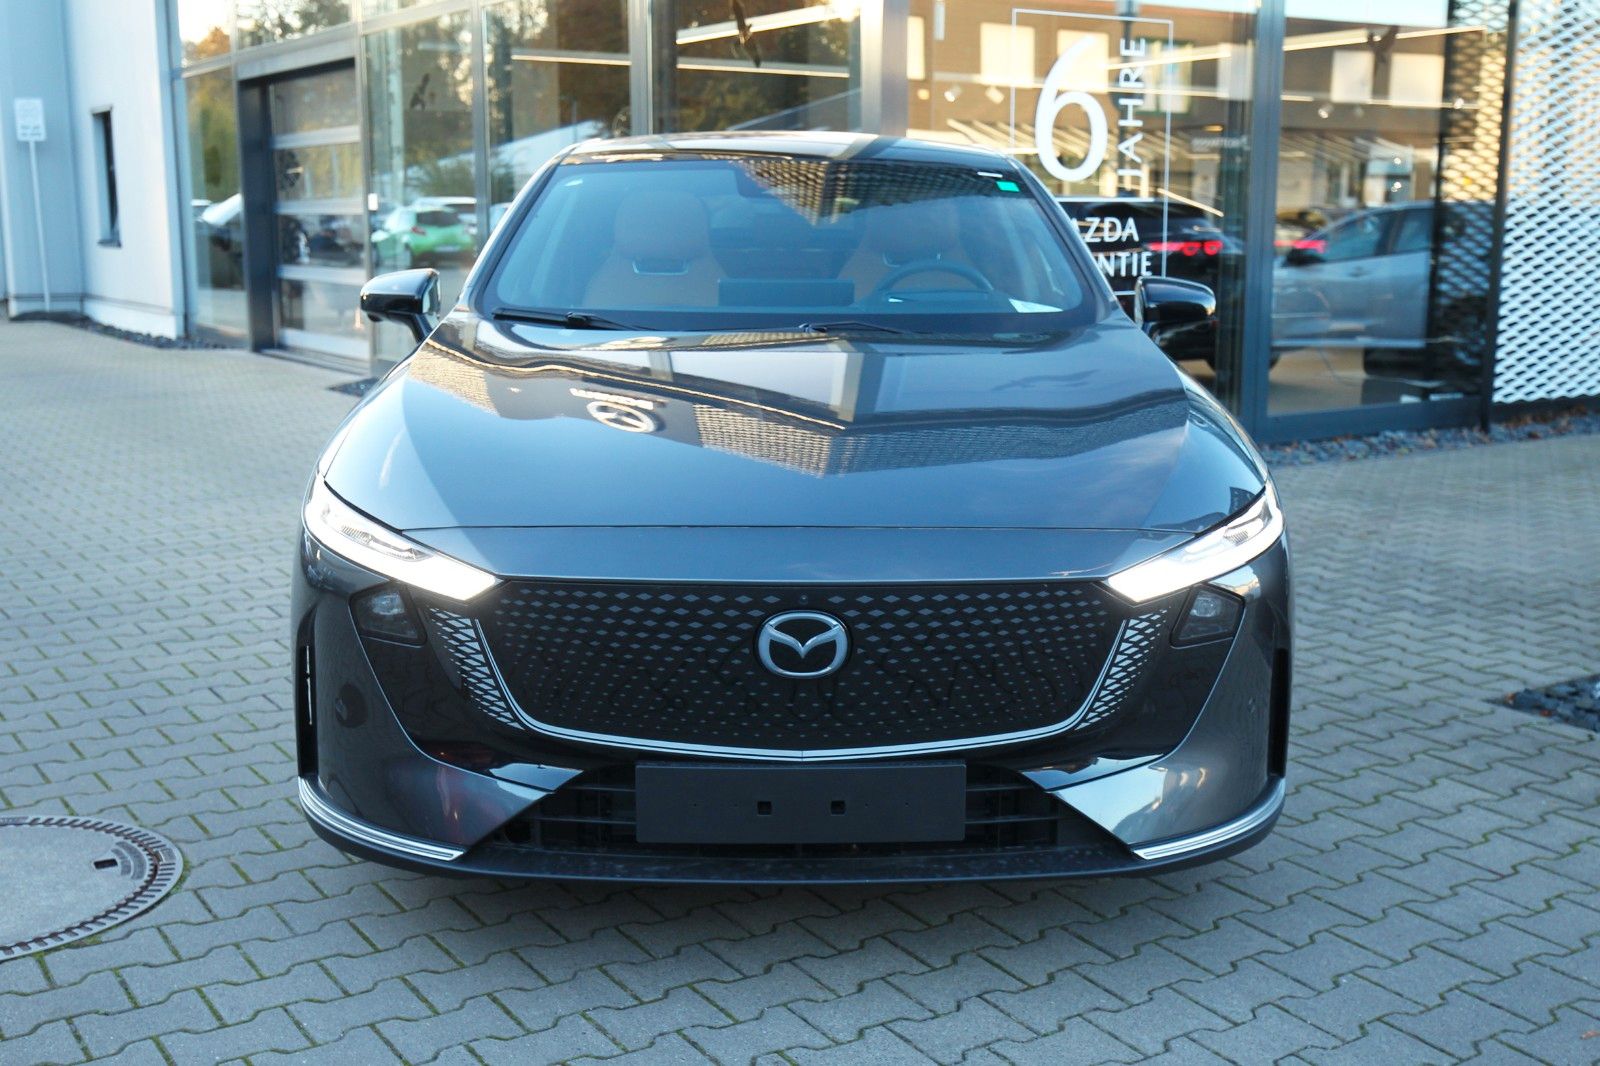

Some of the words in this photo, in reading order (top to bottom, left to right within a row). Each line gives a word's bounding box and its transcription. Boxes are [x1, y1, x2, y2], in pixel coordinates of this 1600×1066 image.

[1034, 35, 1108, 182] 6
[1117, 38, 1146, 178] JAHRE
[1070, 216, 1140, 242] AZDA
[1097, 251, 1153, 277] NTIE
